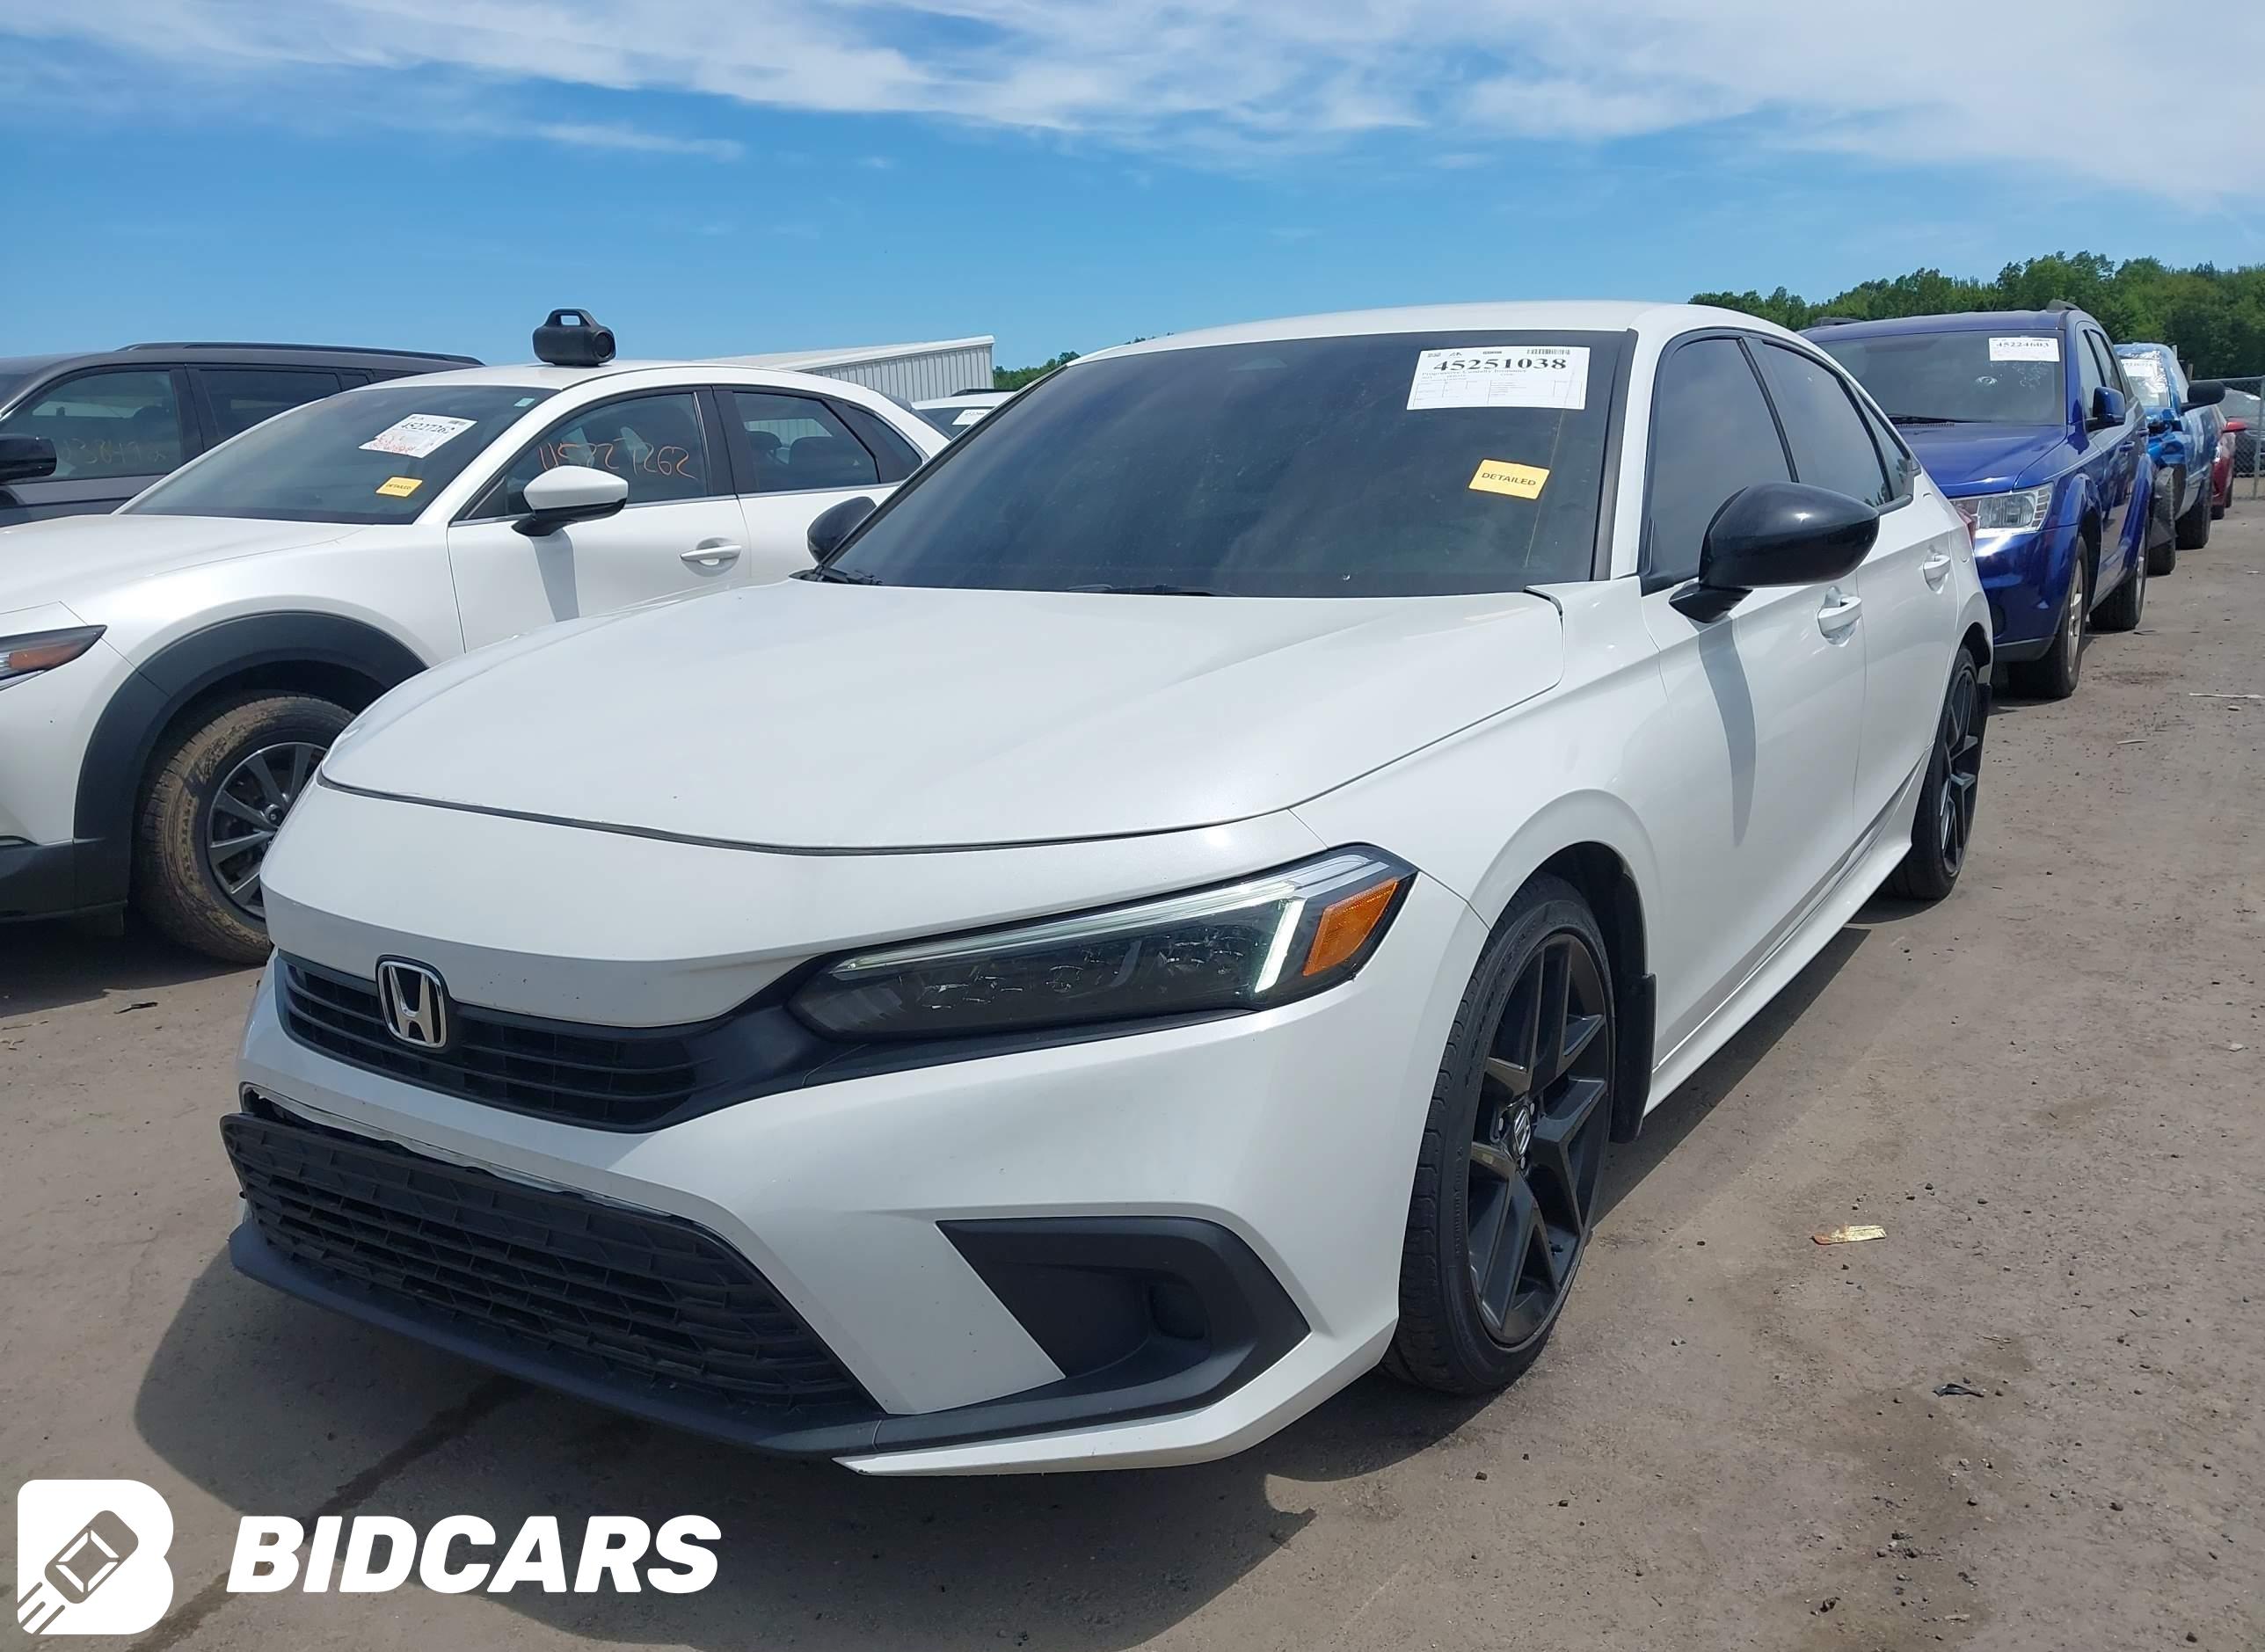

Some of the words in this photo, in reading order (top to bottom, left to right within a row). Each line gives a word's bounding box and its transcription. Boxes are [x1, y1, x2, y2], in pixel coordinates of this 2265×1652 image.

[1433, 358, 1568, 372] 45251038
[1481, 472, 1536, 486] DETAILED
[385, 963, 440, 1046] H
